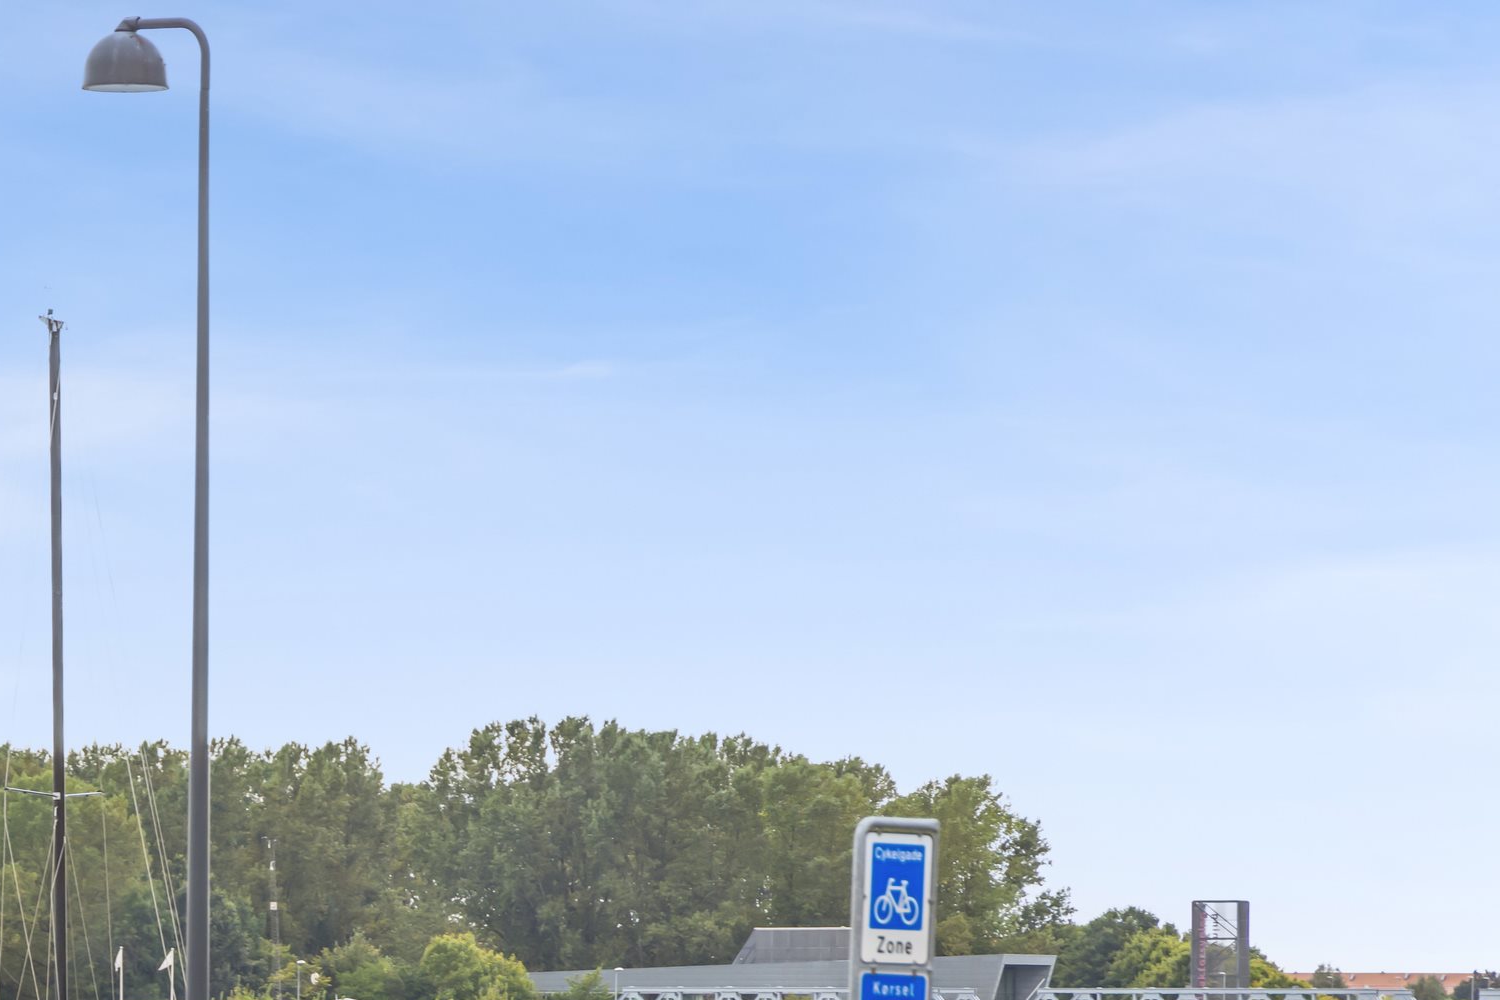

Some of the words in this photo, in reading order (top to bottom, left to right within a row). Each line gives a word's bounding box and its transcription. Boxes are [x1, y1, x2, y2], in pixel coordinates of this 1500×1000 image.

[875, 846, 923, 863] Cykelgade
[877, 935, 913, 955] Zone
[873, 981, 915, 997] Kørsel
